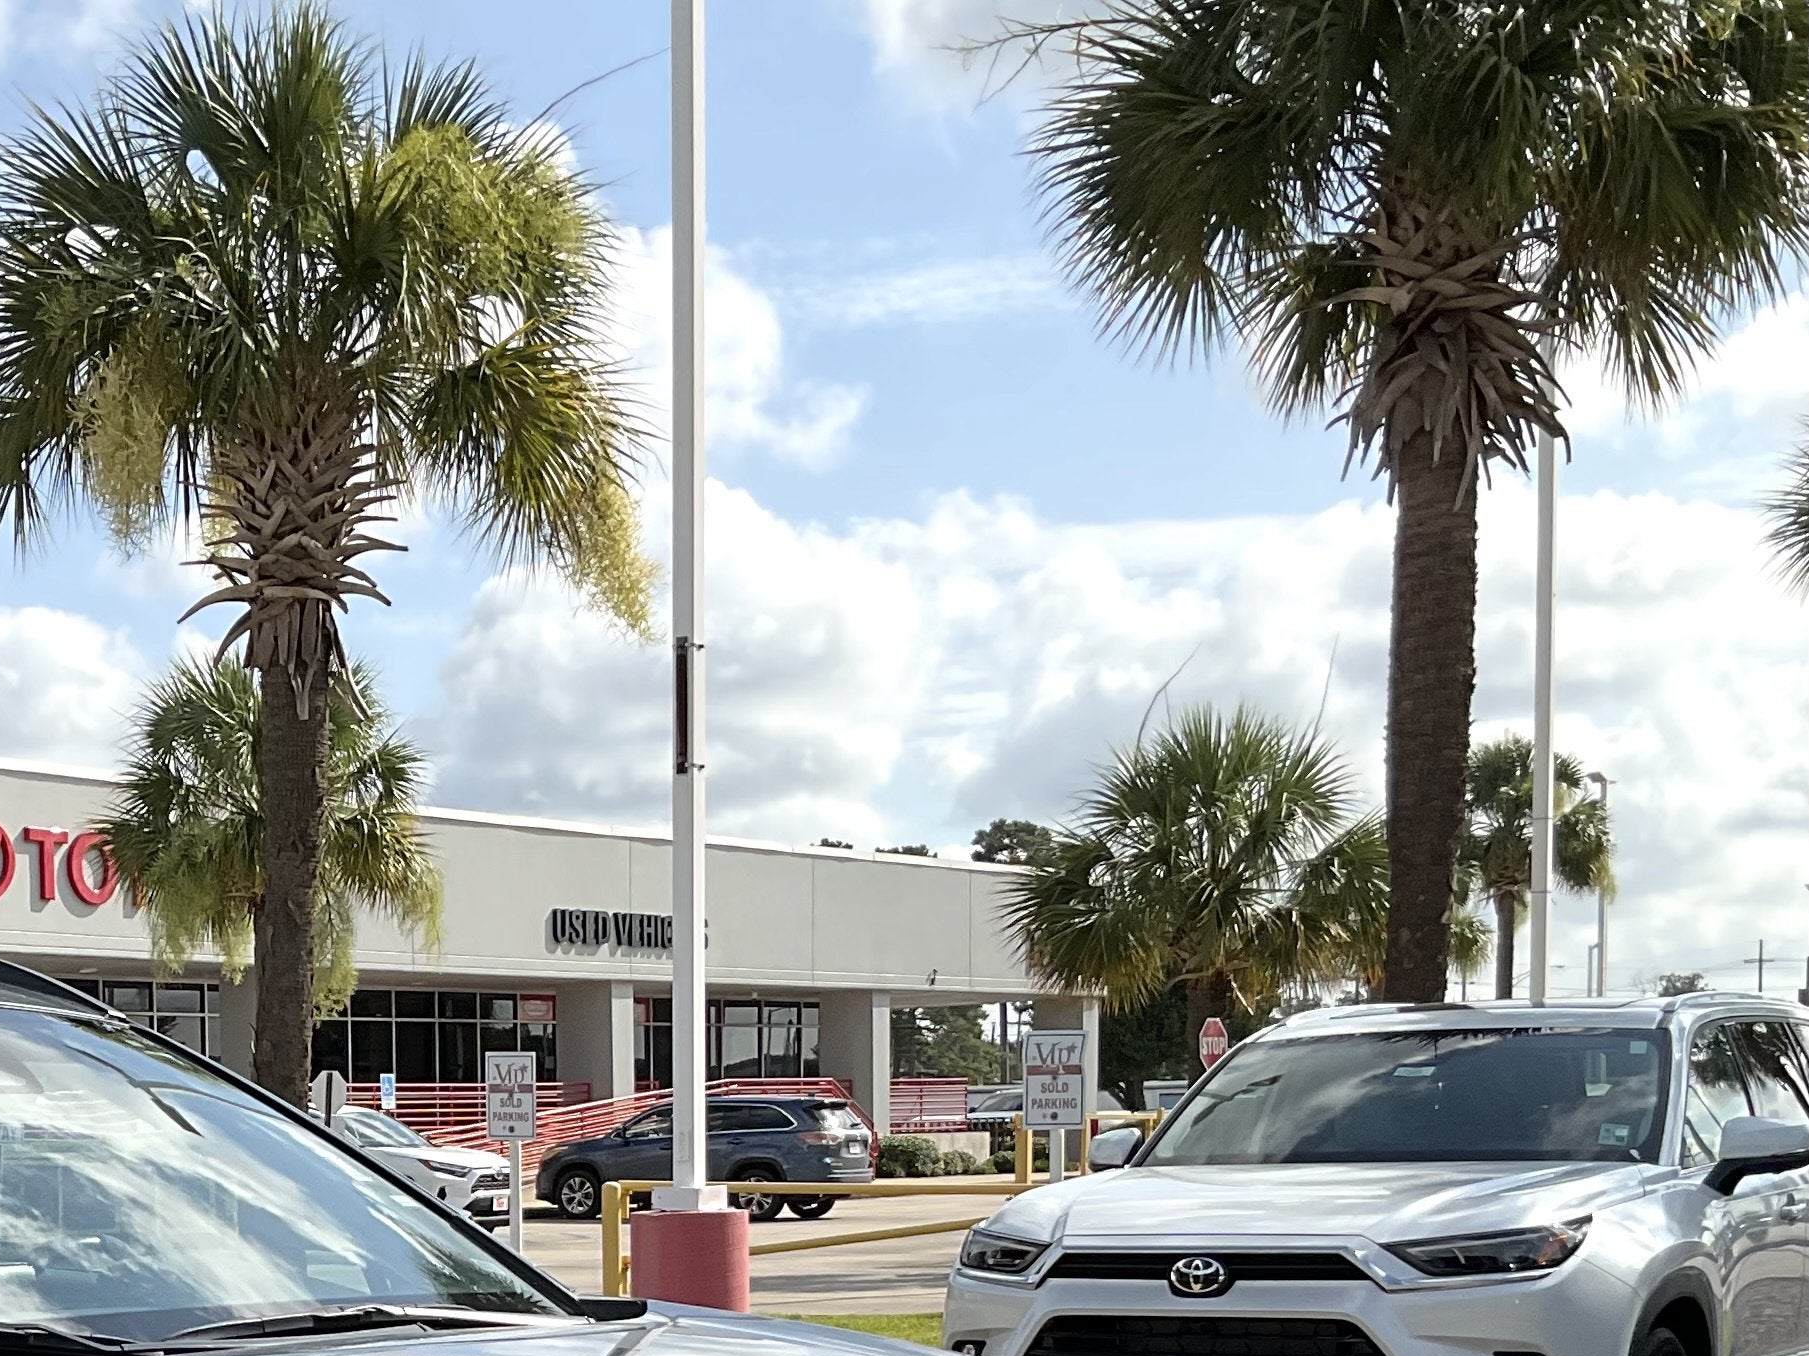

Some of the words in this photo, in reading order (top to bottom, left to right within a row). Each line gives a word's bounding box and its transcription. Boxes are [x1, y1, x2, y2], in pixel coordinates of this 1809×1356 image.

[551, 907, 610, 945] USED
[1202, 1036, 1225, 1055] STOP
[1040, 1082, 1069, 1094] SOLD
[499, 1097, 523, 1109] SOLD
[1031, 1097, 1078, 1109] PARKING
[492, 1111, 529, 1122] PARKING
